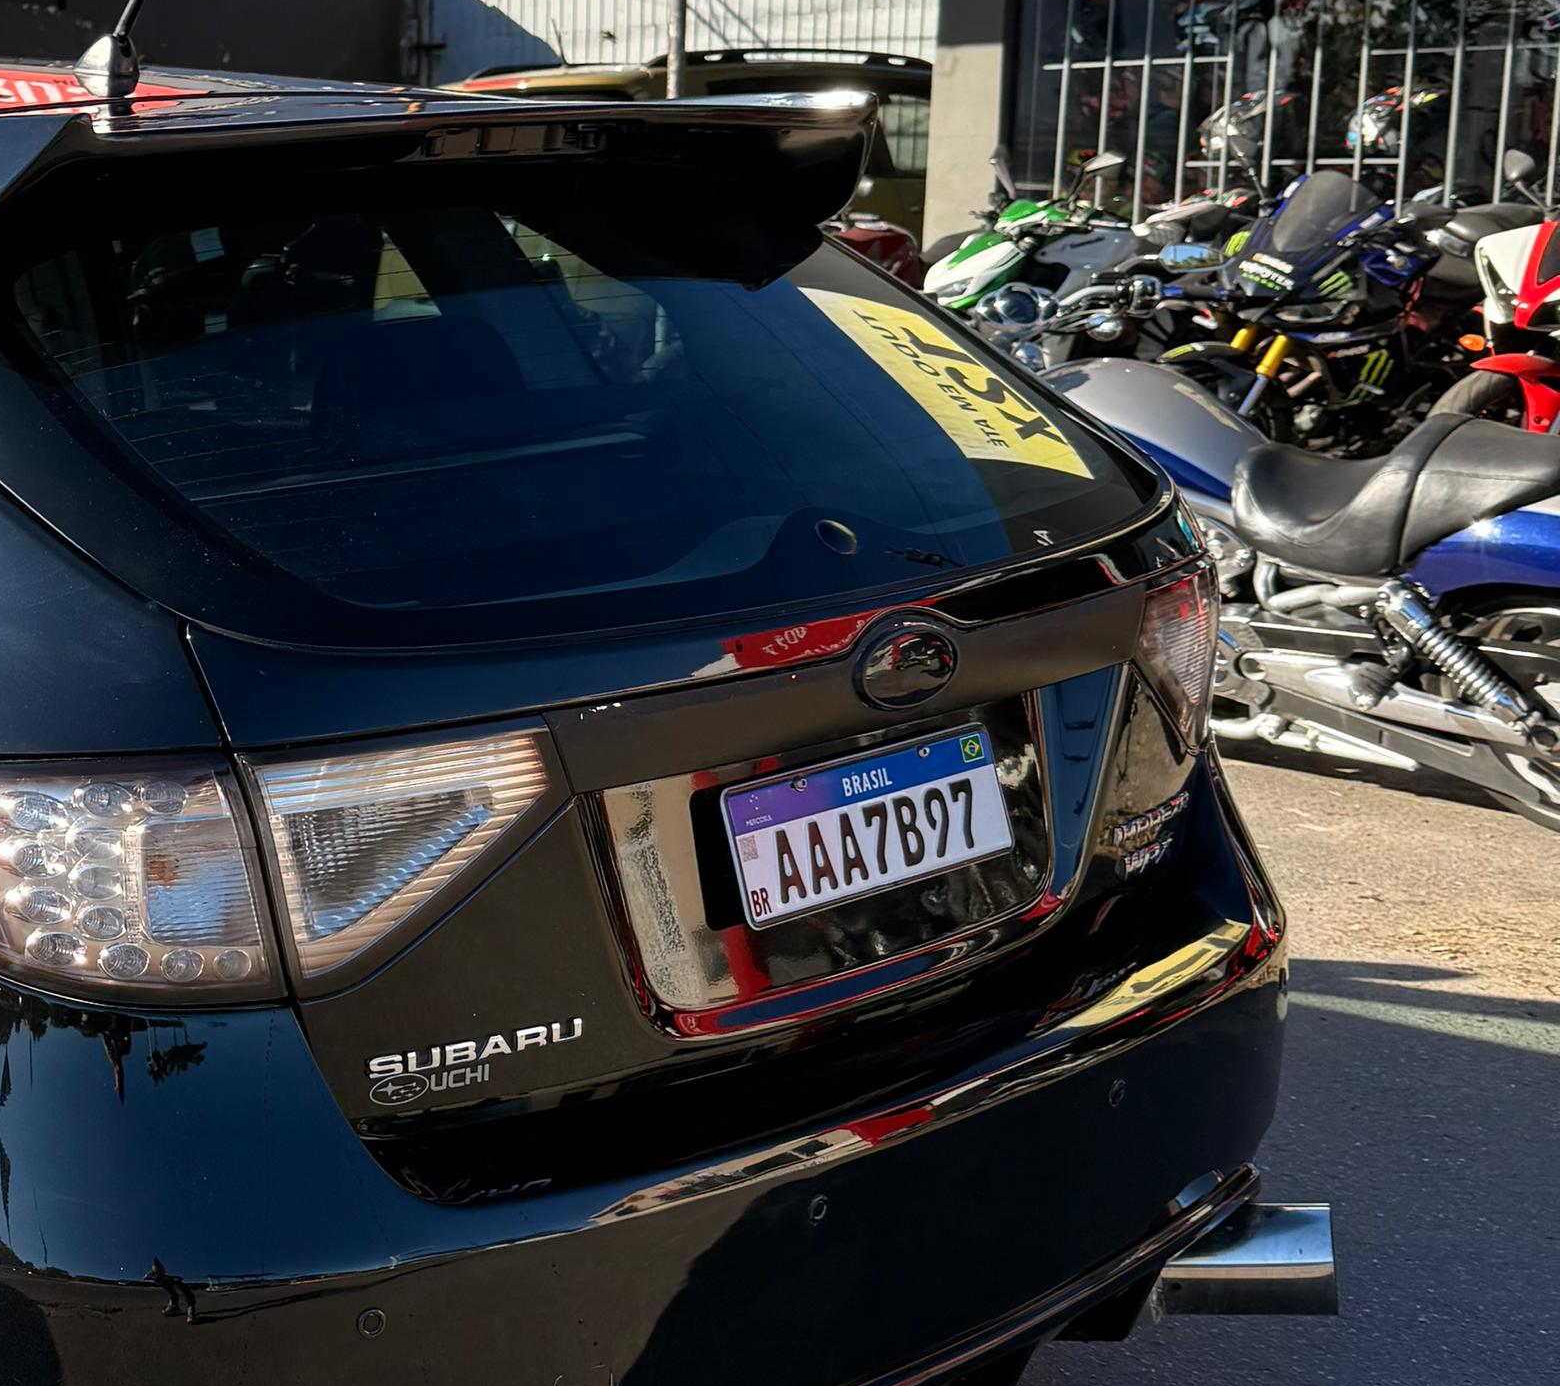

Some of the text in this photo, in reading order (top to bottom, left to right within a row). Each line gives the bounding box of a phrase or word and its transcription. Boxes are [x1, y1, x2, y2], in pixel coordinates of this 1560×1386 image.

[841, 767, 894, 798] BRASIL
[774, 778, 976, 905] AAA7B97
[750, 887, 773, 918] BR
[368, 1016, 583, 1080] SUBARU
[429, 1063, 490, 1092] UCHI
